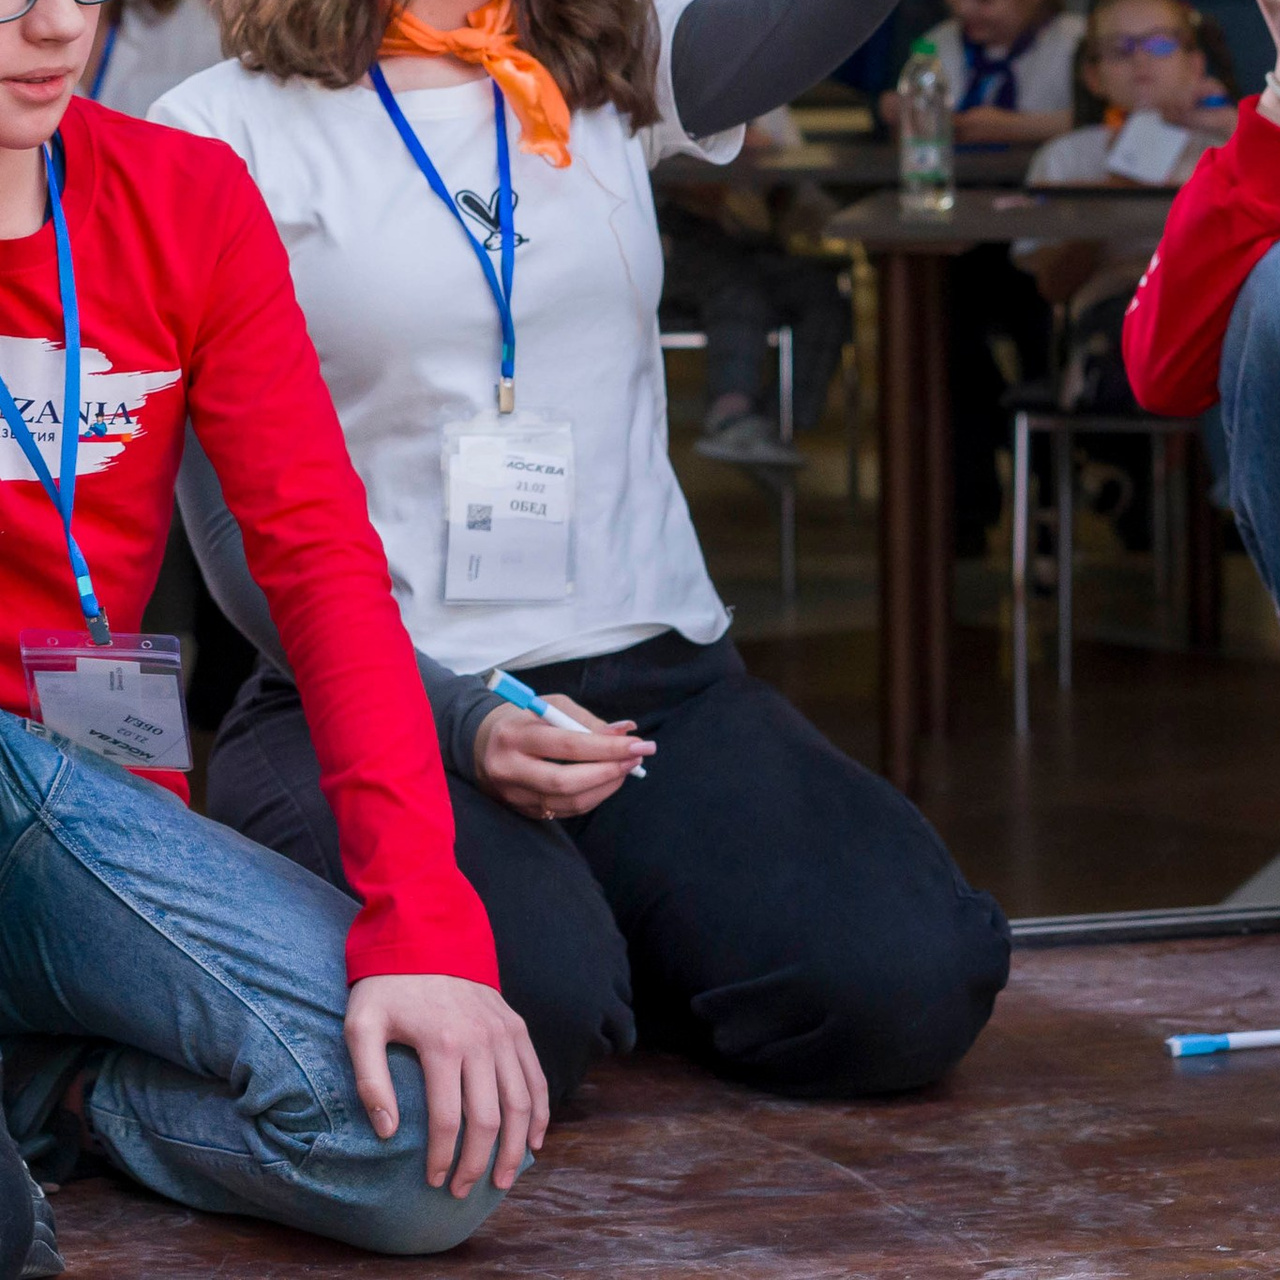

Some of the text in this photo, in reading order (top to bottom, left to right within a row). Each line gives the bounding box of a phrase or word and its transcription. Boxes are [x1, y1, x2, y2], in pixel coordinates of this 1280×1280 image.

[510, 499, 548, 517] ОБЕД
[124, 715, 164, 736] ОБЕД
[89, 729, 155, 759] МОСКВА
